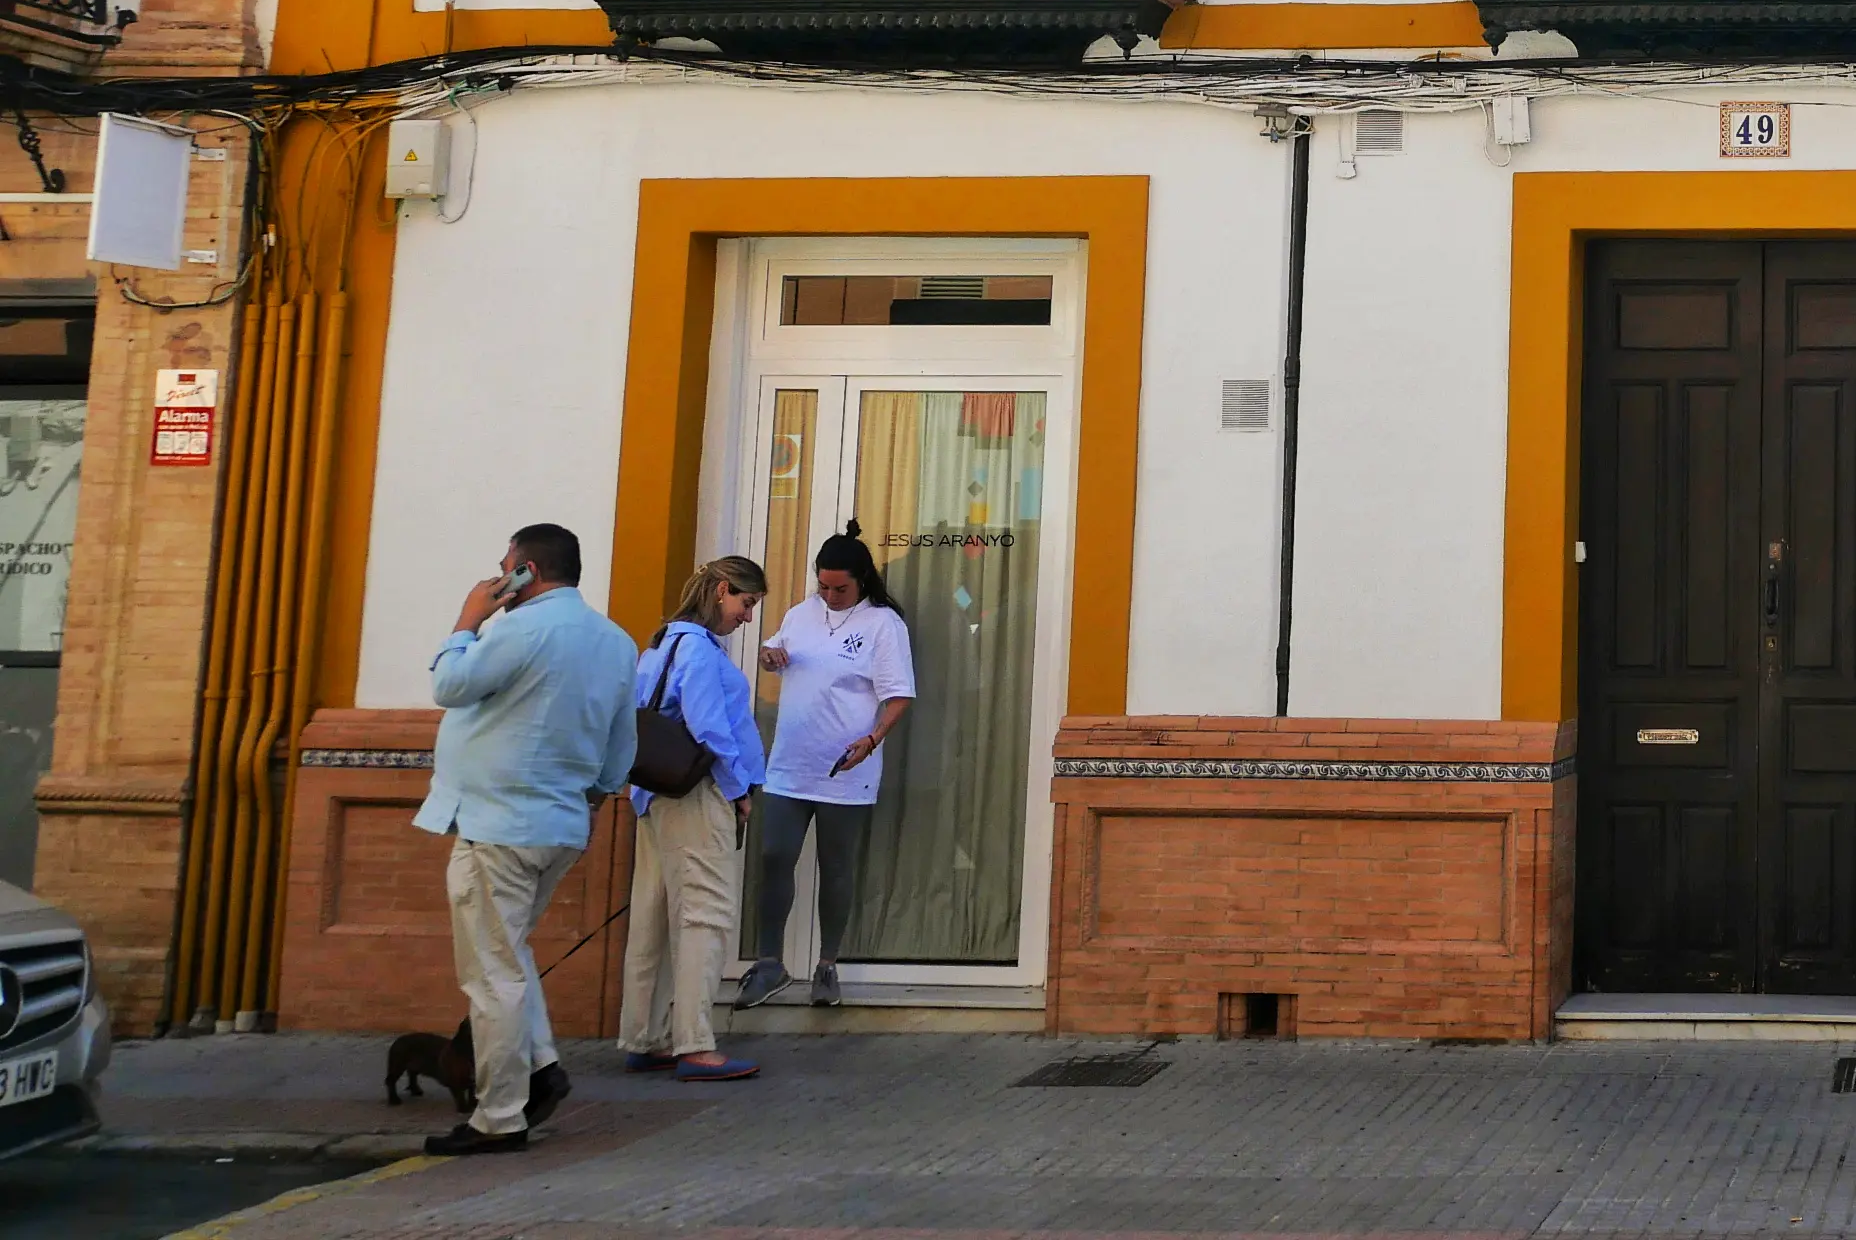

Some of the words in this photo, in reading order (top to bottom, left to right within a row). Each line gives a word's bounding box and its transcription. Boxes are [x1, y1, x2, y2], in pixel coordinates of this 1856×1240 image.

[1736, 114, 1774, 145] 49
[158, 409, 209, 423] Alarma
[878, 533, 934, 547] JESUS
[938, 534, 1015, 547] ARANYO
